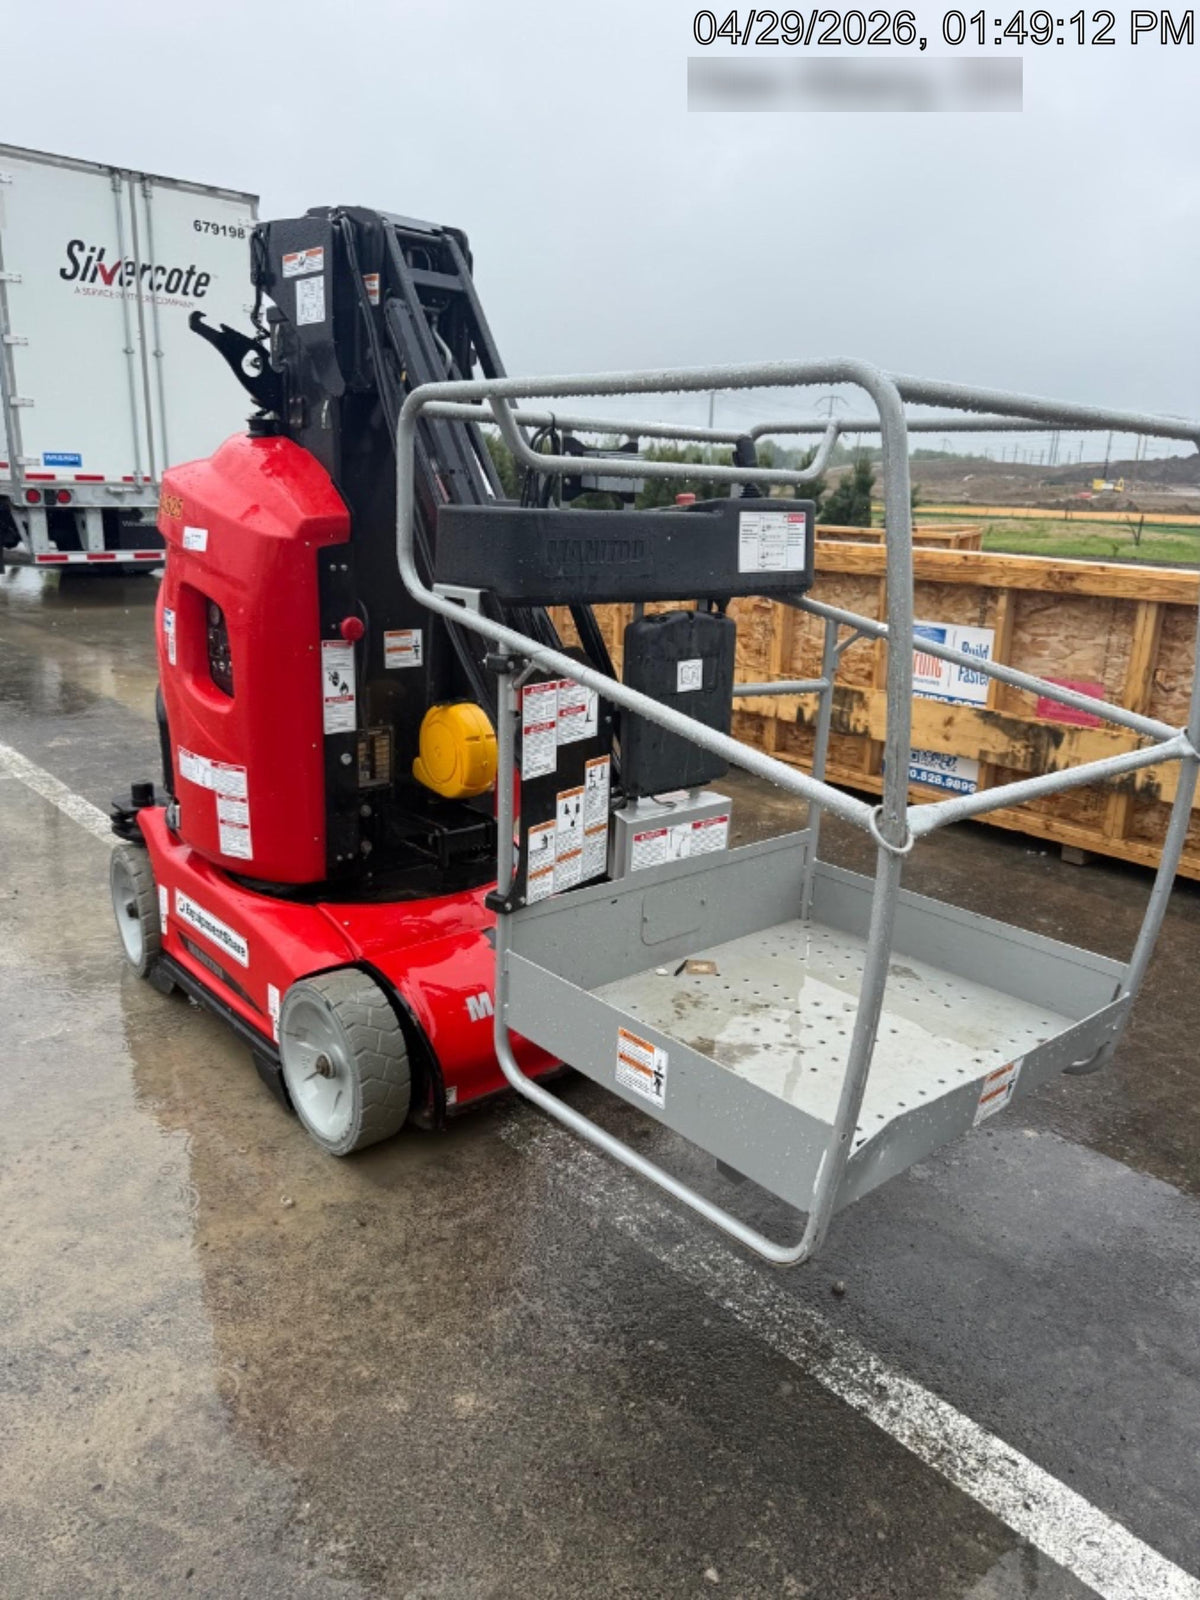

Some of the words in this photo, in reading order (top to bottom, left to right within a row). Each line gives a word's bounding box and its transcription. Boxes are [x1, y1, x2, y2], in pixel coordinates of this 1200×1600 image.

[193, 219, 246, 239] 679198
[59, 239, 211, 298] Silvercote
[962, 641, 990, 660] Build
